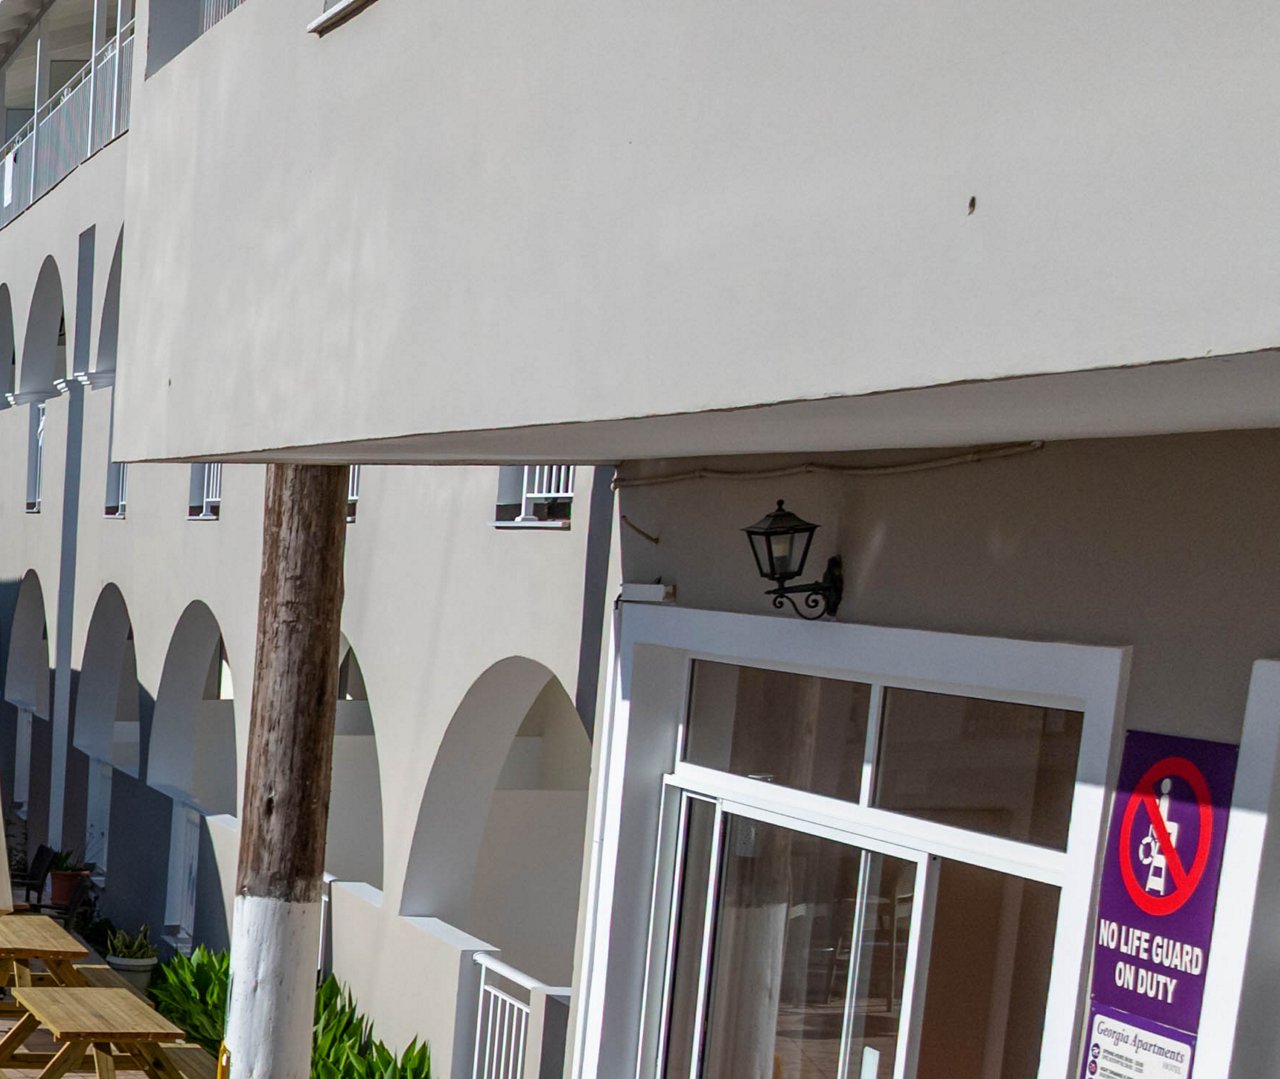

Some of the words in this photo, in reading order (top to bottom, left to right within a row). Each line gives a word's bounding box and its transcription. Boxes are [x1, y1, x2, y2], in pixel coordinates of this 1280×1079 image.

[1099, 919, 1118, 949] NO
[1120, 925, 1150, 960] LIFE
[1152, 935, 1203, 975] GUARD
[1115, 961, 1135, 990] ON
[1137, 968, 1177, 1003] DUTY
[1097, 1021, 1129, 1046] Georgia
[1130, 1034, 1185, 1064] Apartments
